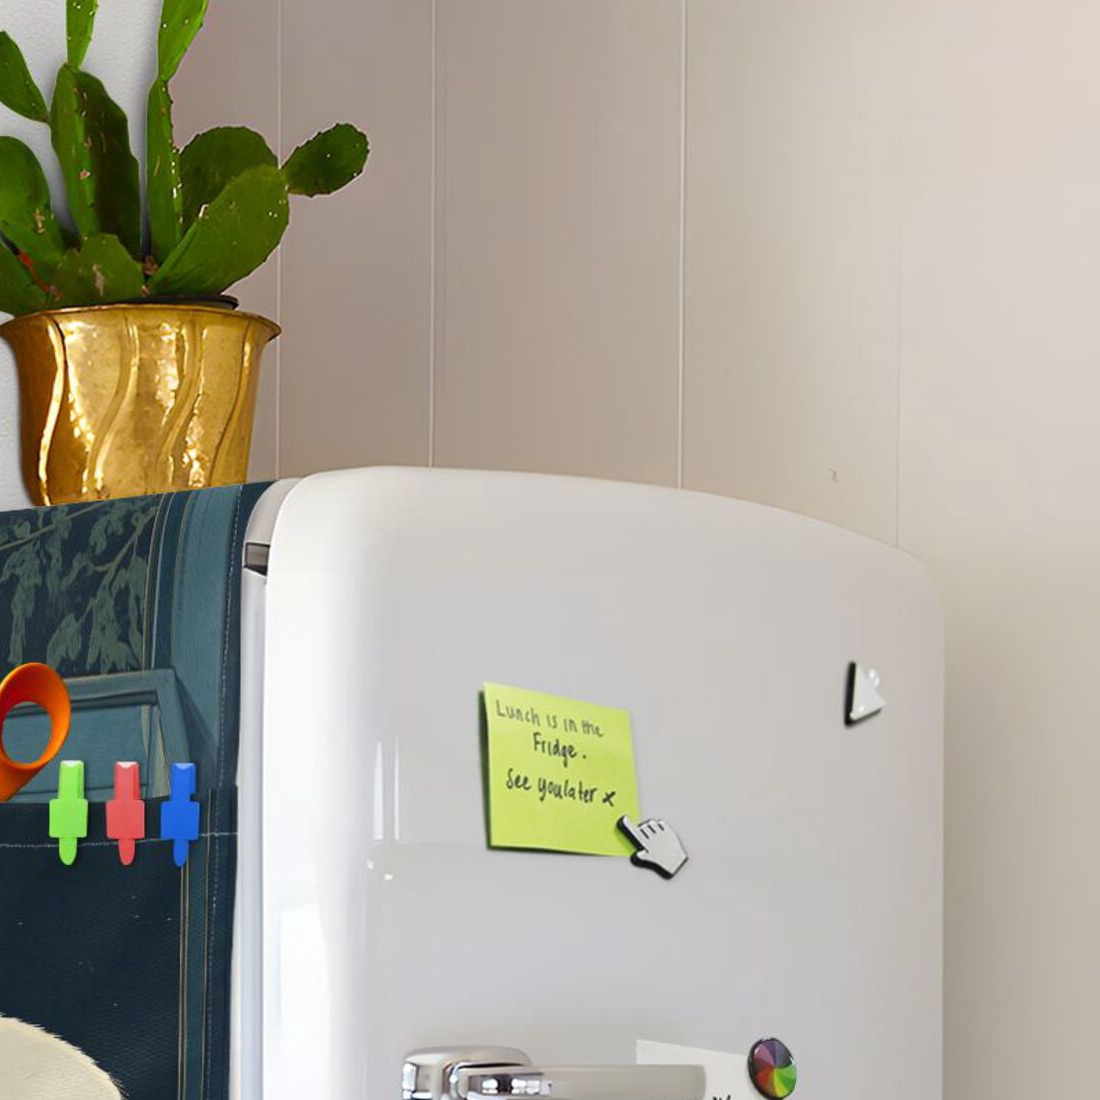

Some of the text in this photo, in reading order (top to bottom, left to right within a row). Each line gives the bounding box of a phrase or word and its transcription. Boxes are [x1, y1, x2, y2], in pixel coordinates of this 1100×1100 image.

[496, 699, 604, 737] Lunch is in the
[506, 768, 532, 790] See
